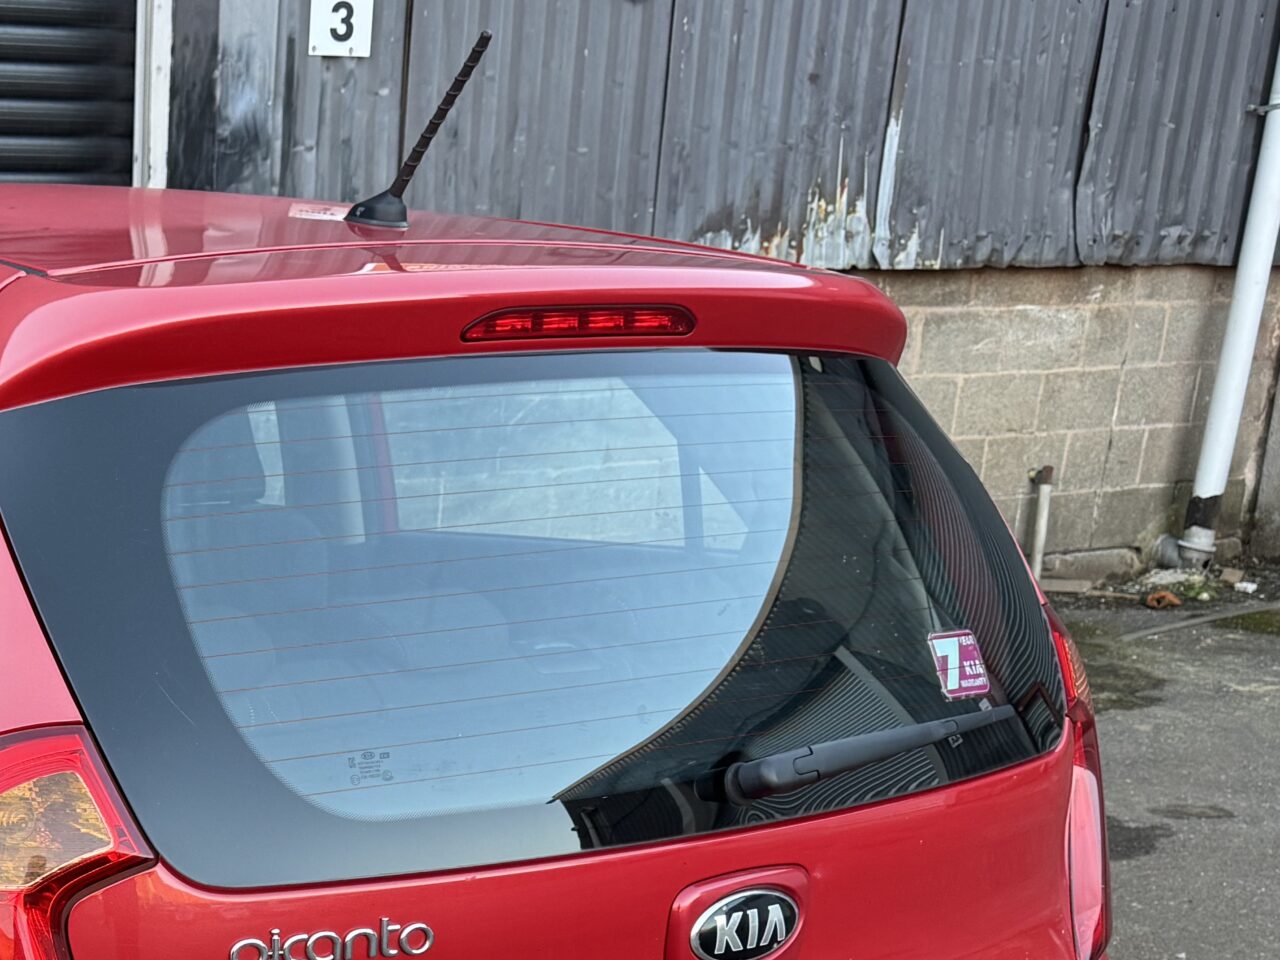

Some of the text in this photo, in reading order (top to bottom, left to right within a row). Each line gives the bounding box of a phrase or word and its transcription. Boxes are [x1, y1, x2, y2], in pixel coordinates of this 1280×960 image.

[329, 1, 354, 42] 3
[963, 660, 984, 676] KIA
[714, 903, 787, 954] KIA
